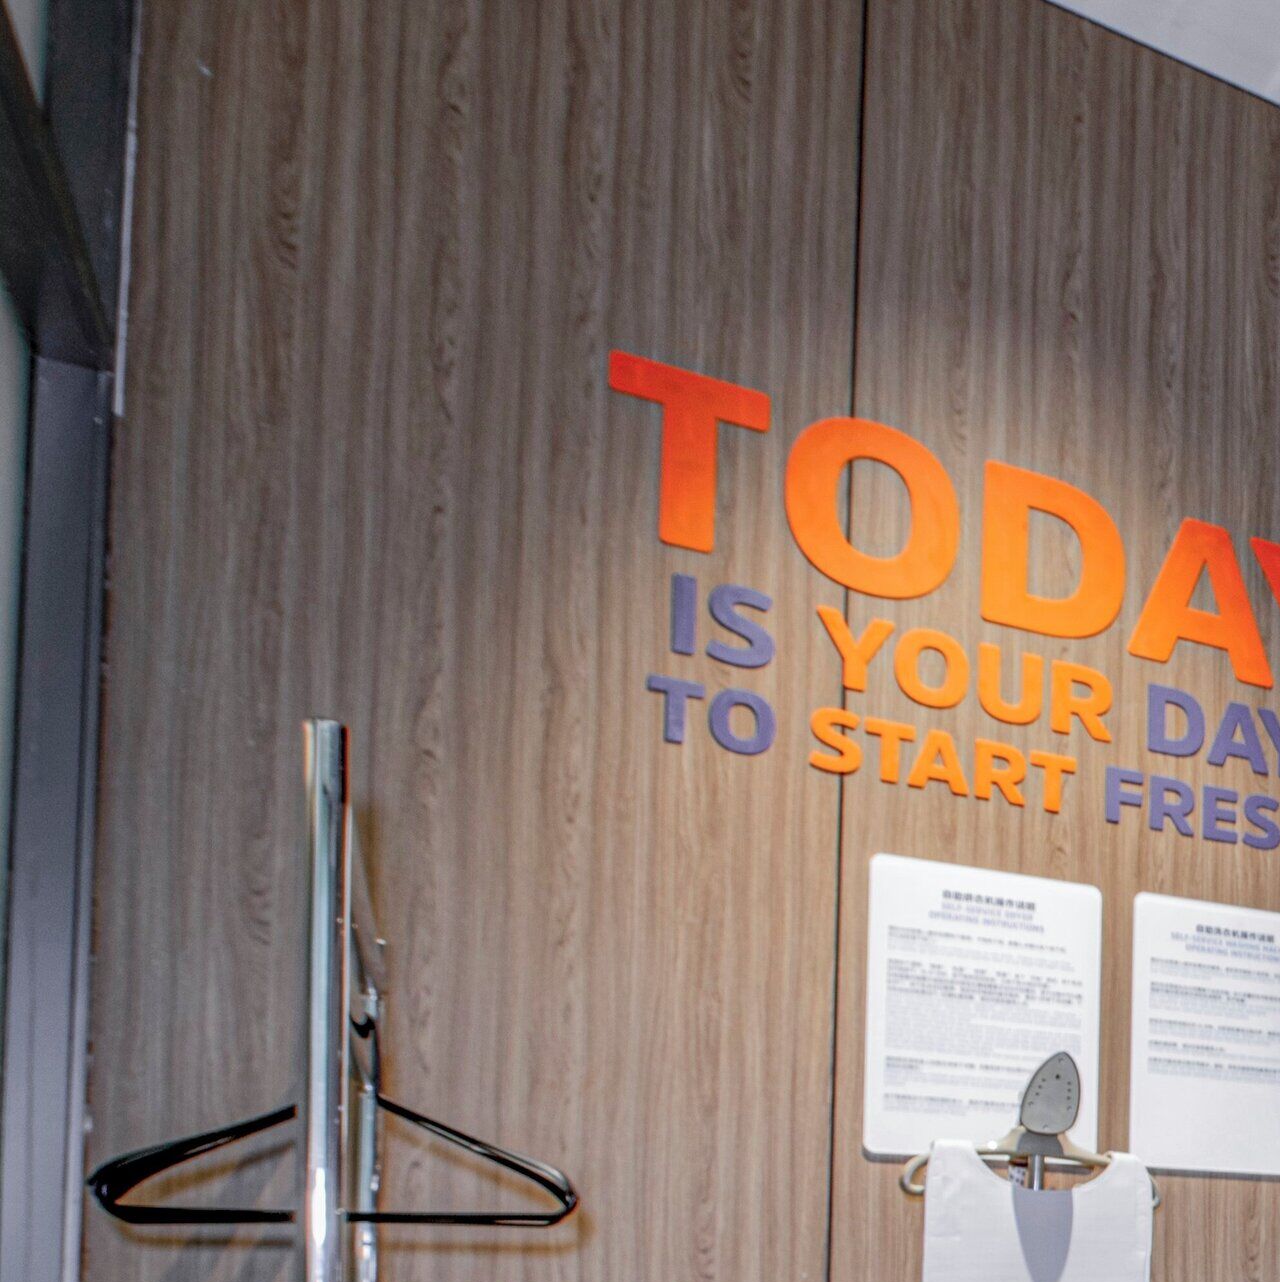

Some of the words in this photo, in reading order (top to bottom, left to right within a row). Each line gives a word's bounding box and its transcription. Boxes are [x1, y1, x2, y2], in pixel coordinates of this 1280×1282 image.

[671, 574, 776, 668] IS
[816, 605, 1113, 742] YOUR
[646, 674, 777, 754] TO
[808, 707, 1076, 812] START
